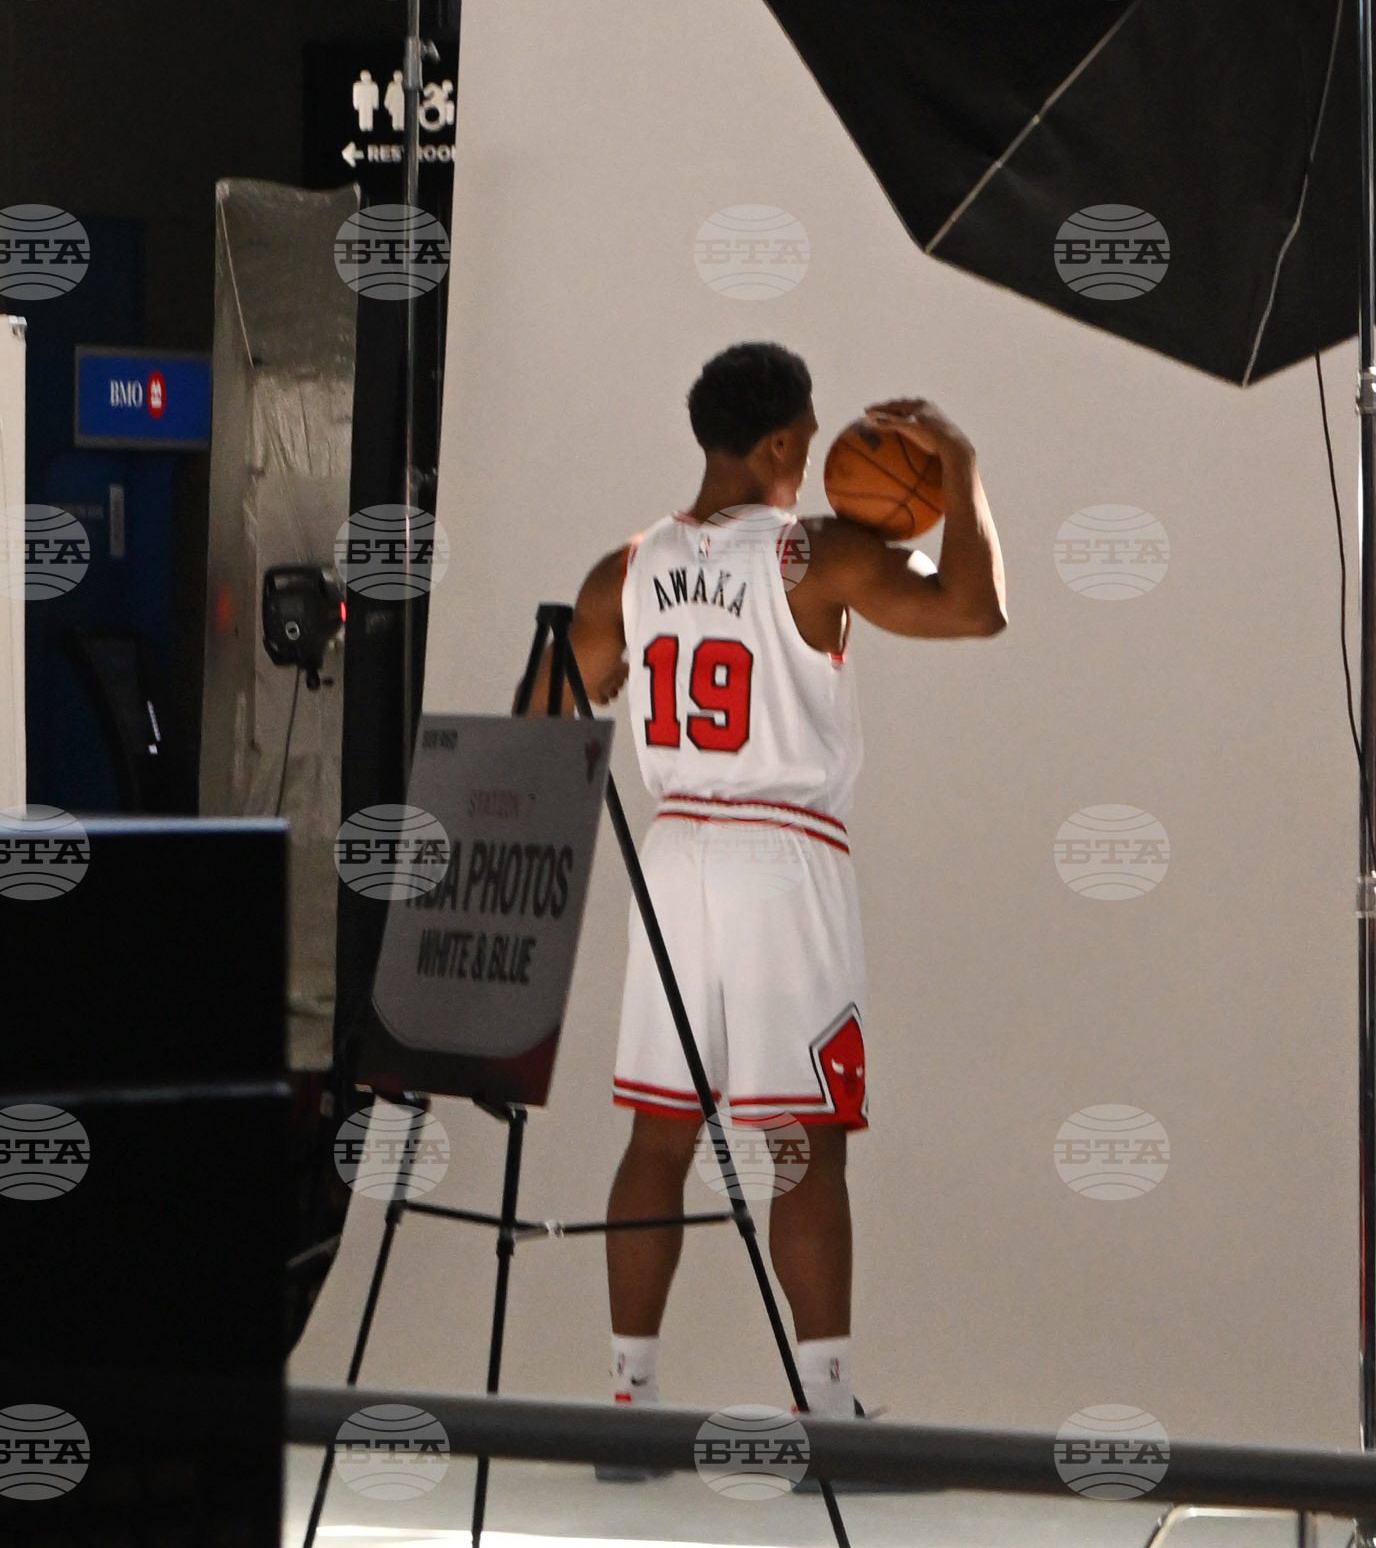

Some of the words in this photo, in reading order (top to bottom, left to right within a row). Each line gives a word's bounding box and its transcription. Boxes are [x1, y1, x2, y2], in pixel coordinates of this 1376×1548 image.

[110, 379, 143, 408] BMO
[653, 567, 747, 618] AWAKA
[643, 634, 754, 753] 19
[462, 840, 574, 919] PHOTOS
[416, 927, 474, 979] WHITE
[471, 931, 488, 983] &
[488, 934, 537, 986] BLUE
